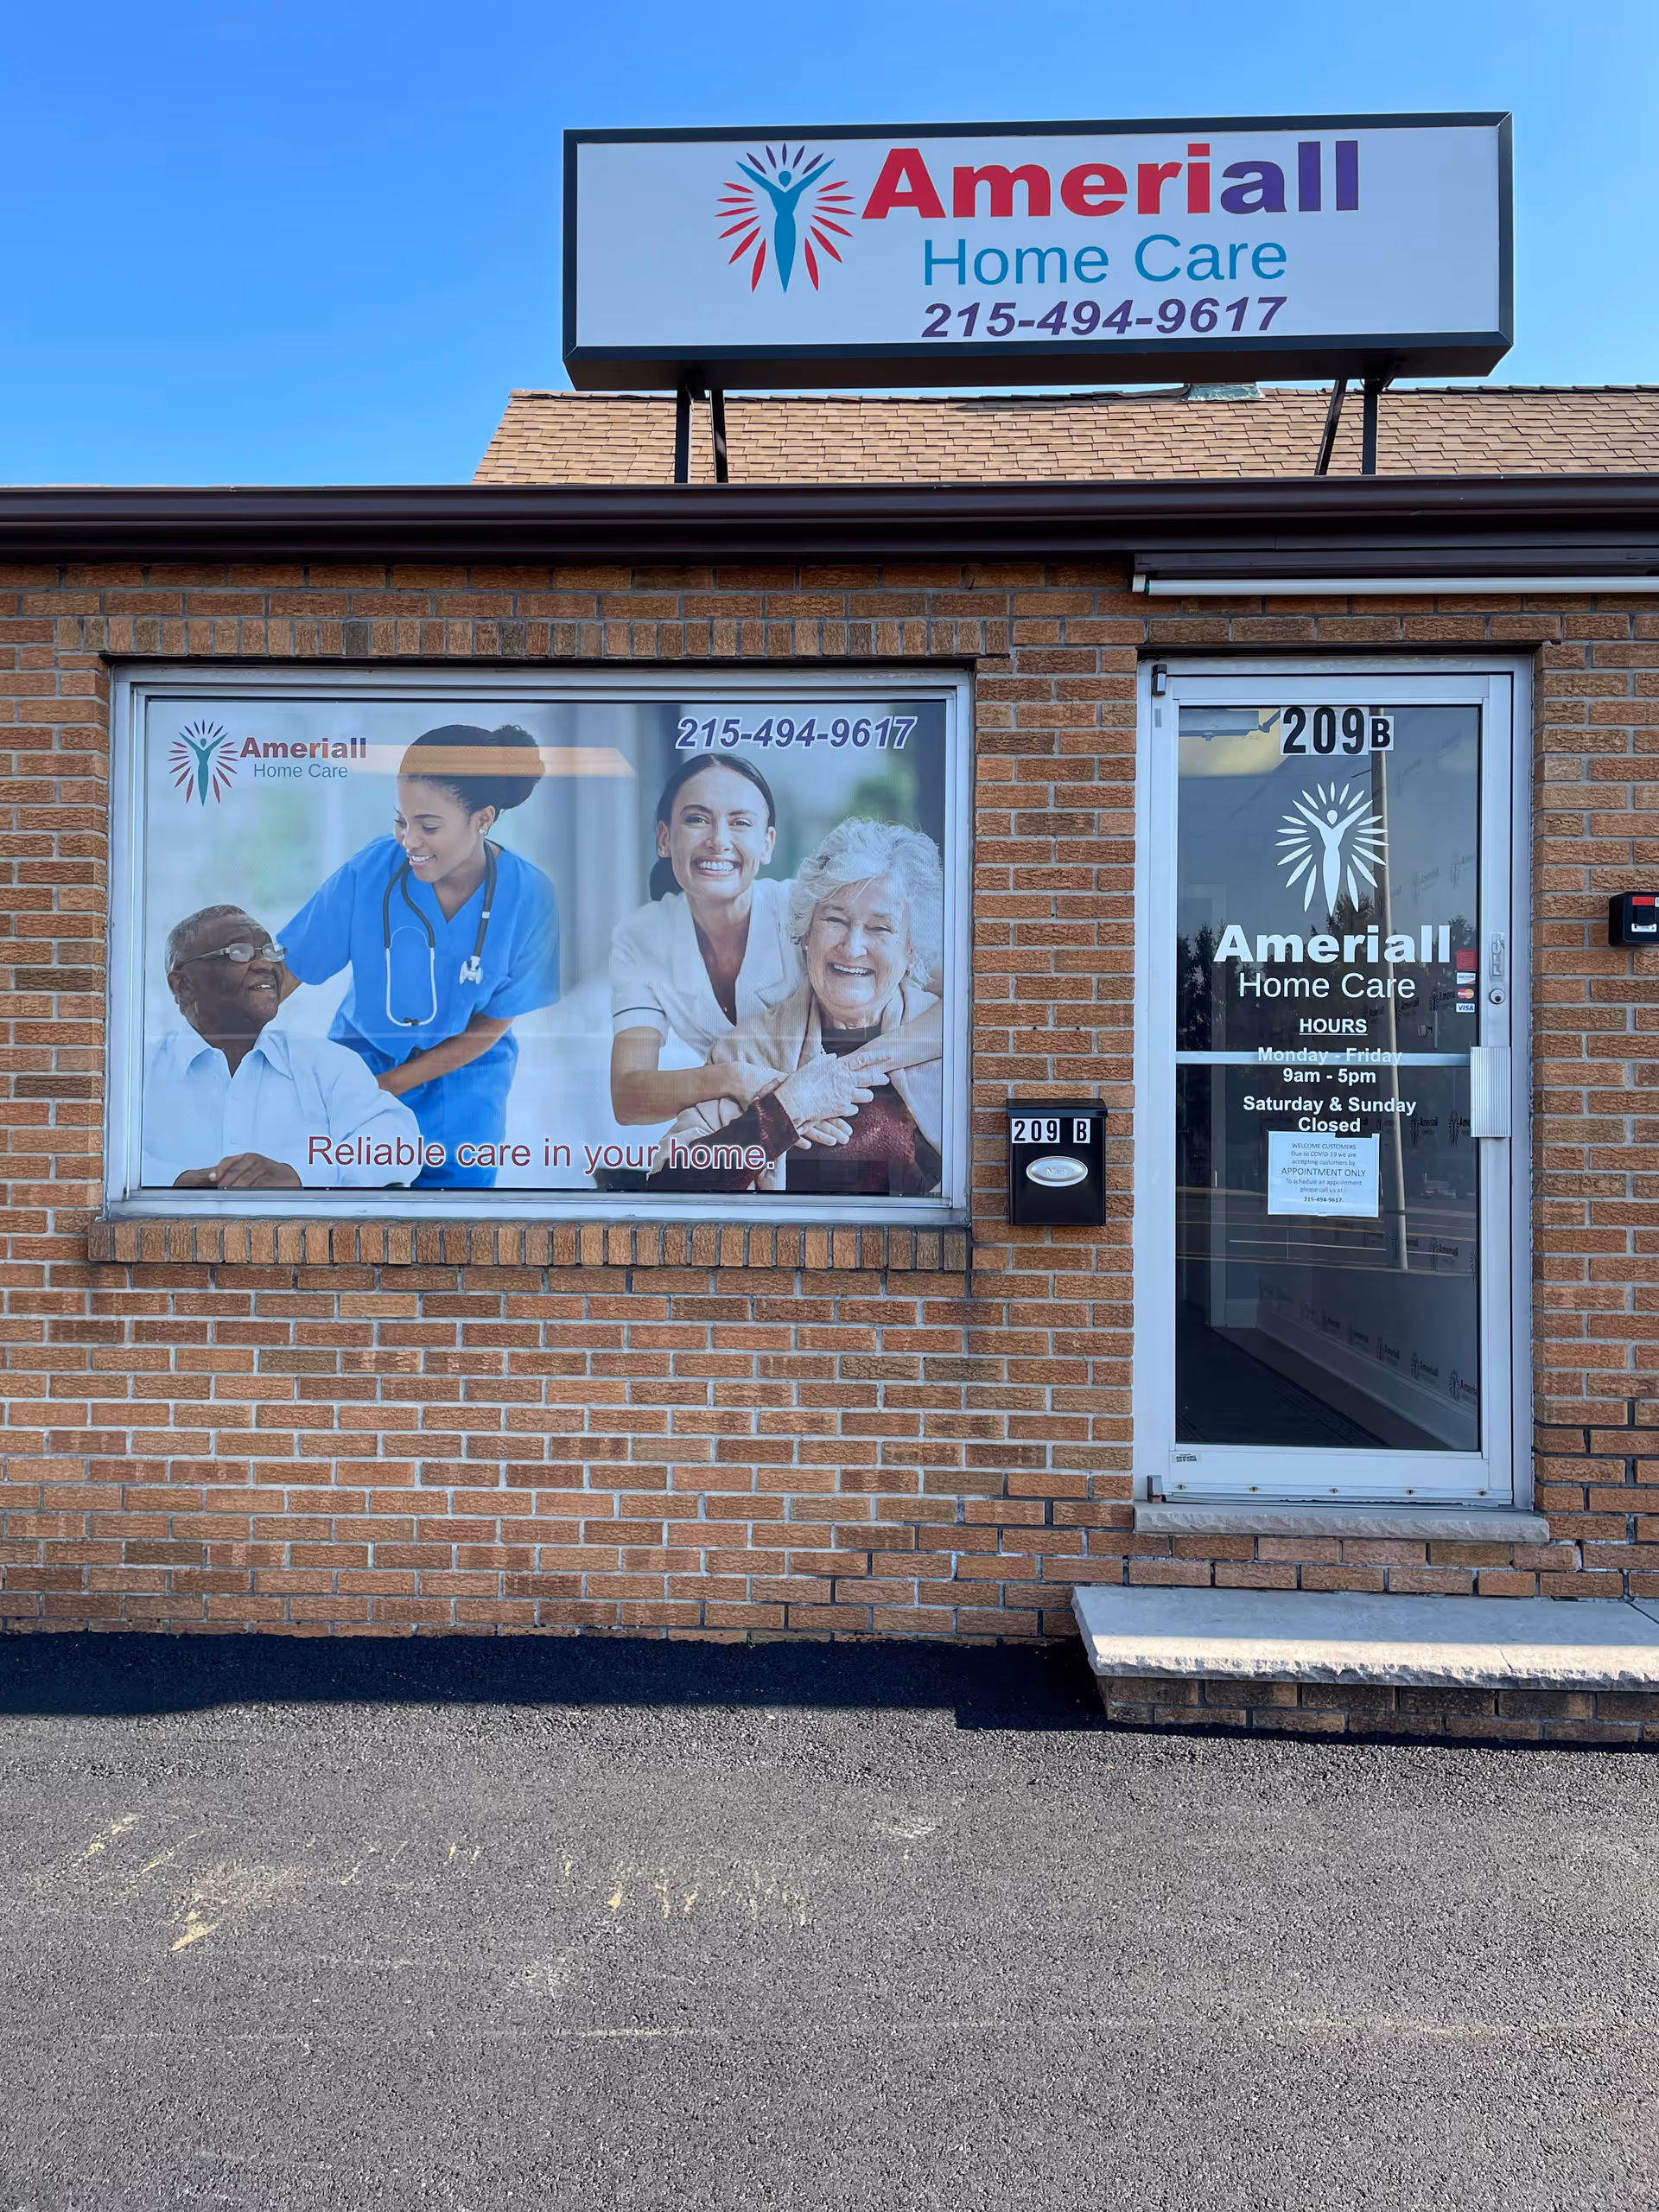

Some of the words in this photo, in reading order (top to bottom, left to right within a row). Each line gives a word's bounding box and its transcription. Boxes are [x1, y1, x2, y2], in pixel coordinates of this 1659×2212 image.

[861, 139, 1359, 220] Ameriall
[925, 238, 1109, 286] Home
[1135, 233, 1287, 283] Care
[922, 296, 1287, 340] 215-494-9617
[677, 716, 917, 748] 215-494-9617
[239, 737, 366, 759] Ameriall
[254, 764, 302, 778] Home
[308, 764, 348, 778] Care
[1213, 925, 1451, 964] Ameriall
[1239, 972, 1330, 998] Home
[1341, 972, 1416, 999] Care
[1299, 1019, 1368, 1034] HOURS
[1258, 1047, 1329, 1065] Monday
[1346, 1048, 1403, 1066] Friday
[1283, 1068, 1320, 1083] 9am
[1338, 1069, 1376, 1086] 5pm
[1243, 1096, 1324, 1115] Saturday
[1329, 1096, 1343, 1112] &
[1348, 1097, 1417, 1116] Sunday
[1014, 1120, 1058, 1141] 209
[1076, 1121, 1087, 1141] B
[1298, 1117, 1361, 1132] Closed
[308, 1136, 445, 1166] Reliable
[456, 1143, 531, 1166] care
[544, 1138, 570, 1166] in
[584, 1145, 659, 1174] your
[670, 1138, 775, 1168] home.
[1281, 1167, 1343, 1177] APPOINTMENT
